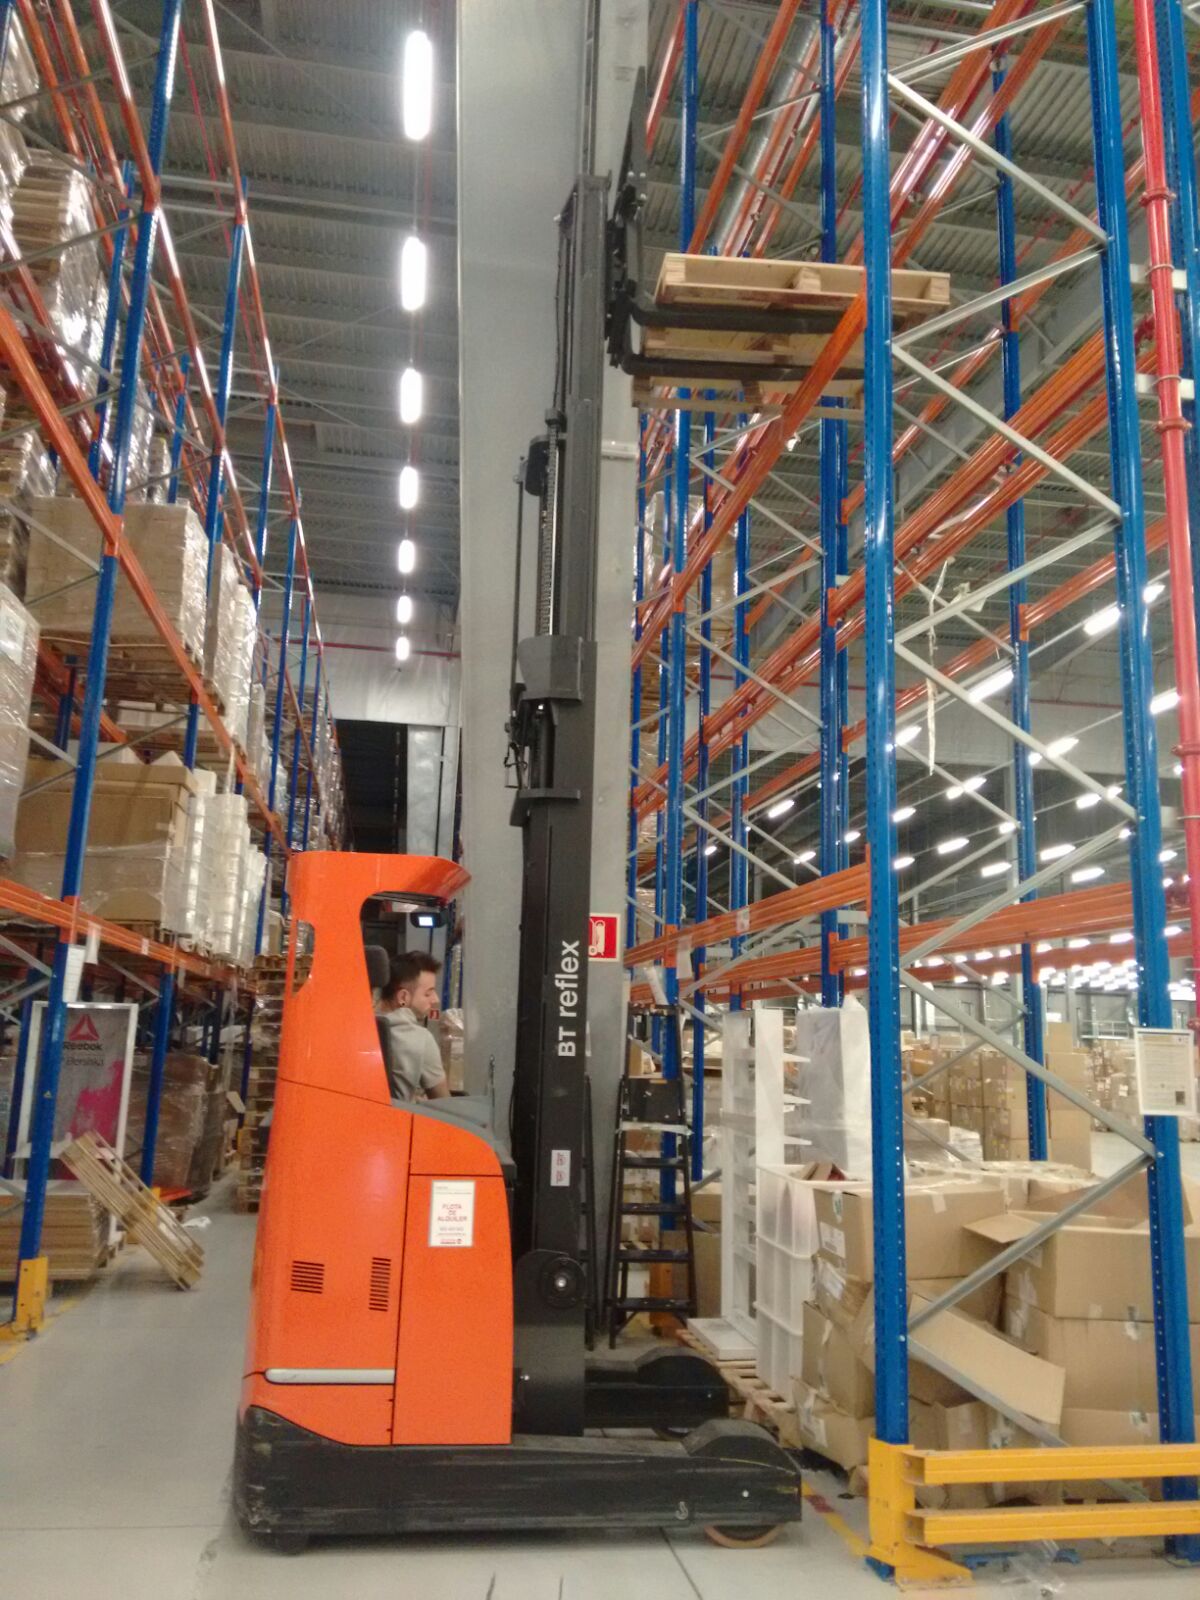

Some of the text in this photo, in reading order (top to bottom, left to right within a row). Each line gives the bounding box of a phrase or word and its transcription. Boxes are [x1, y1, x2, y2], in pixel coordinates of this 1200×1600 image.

[555, 940, 580, 1056] BT reflex
[63, 1041, 102, 1050] Reebok
